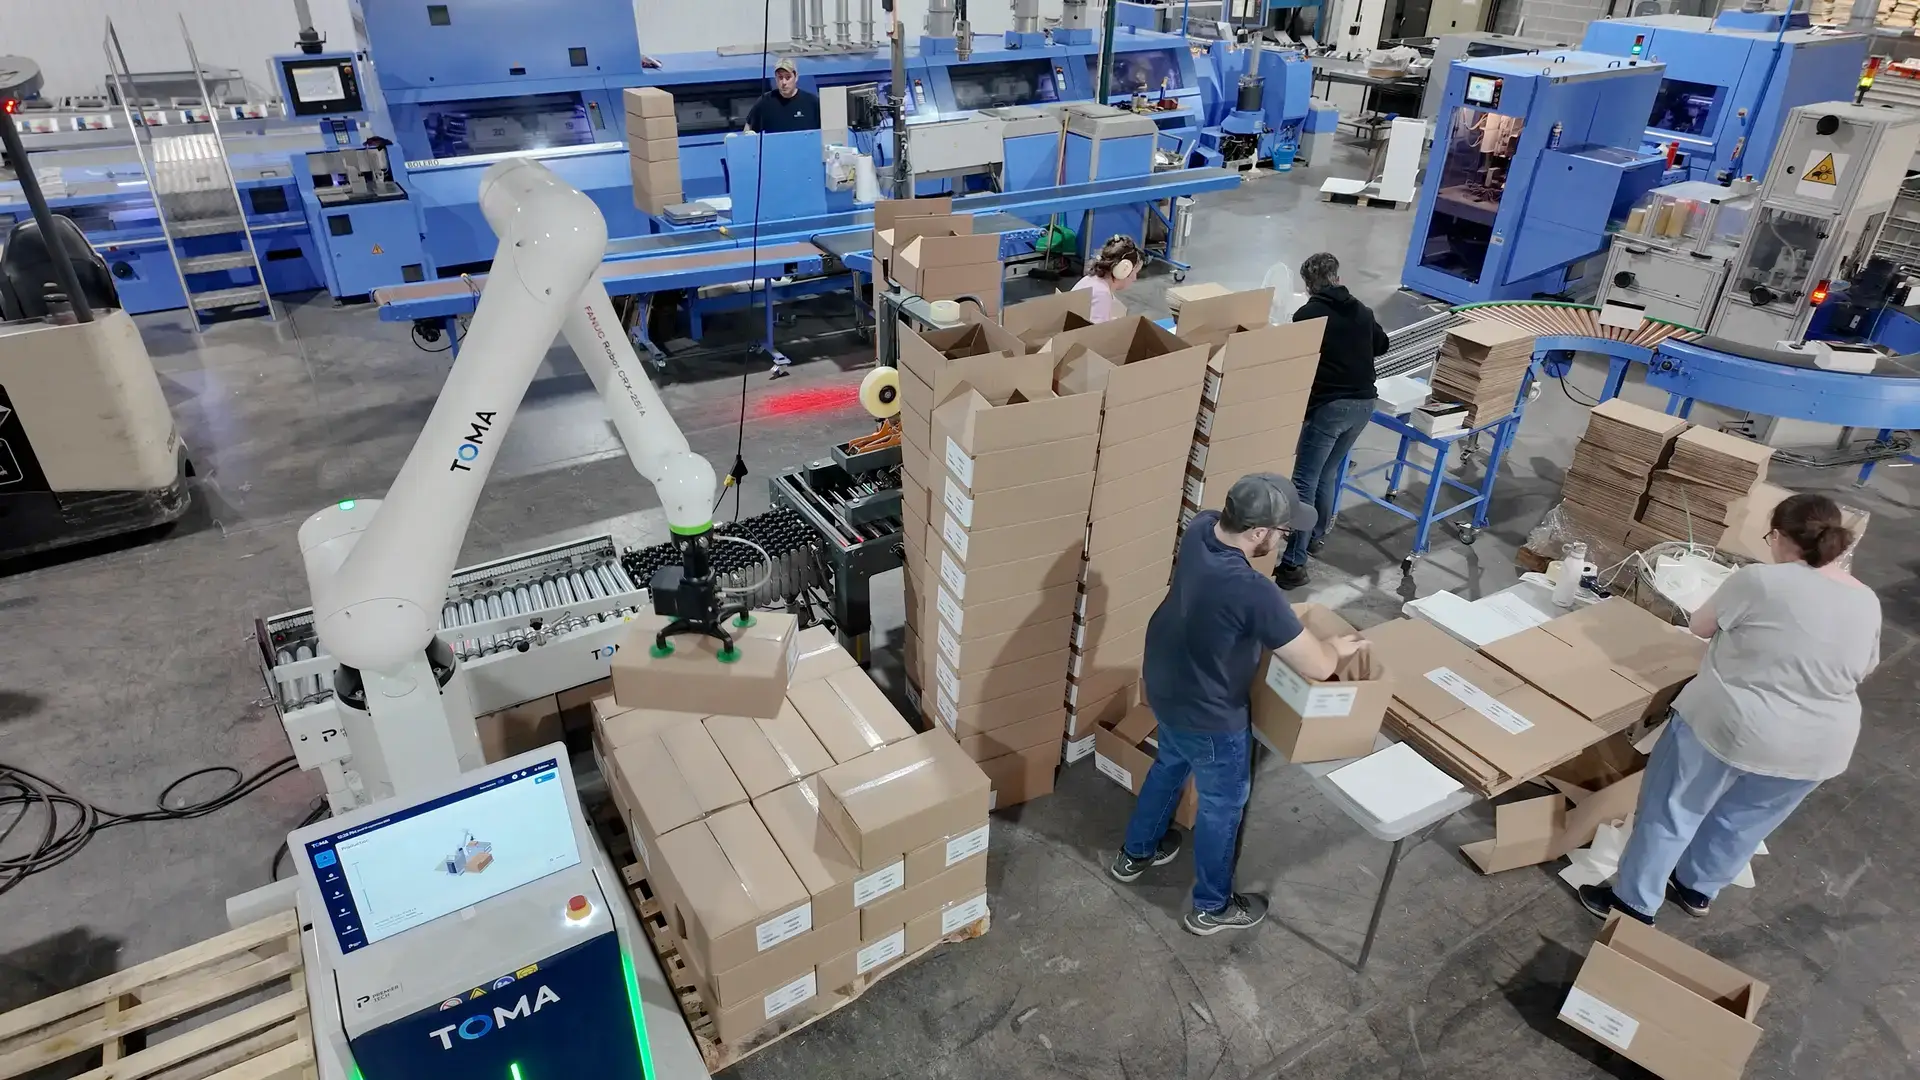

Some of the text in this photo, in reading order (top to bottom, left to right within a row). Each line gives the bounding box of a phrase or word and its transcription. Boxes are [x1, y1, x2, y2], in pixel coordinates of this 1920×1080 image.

[407, 159, 439, 168] BOLERO
[584, 305, 605, 339] FANUC
[602, 341, 620, 369] Robot
[449, 412, 497, 471] TOMA
[311, 839, 329, 848] TOMA
[372, 984, 399, 998] PREMIER
[374, 993, 390, 1002] TECH
[429, 984, 561, 1050] TOMA
